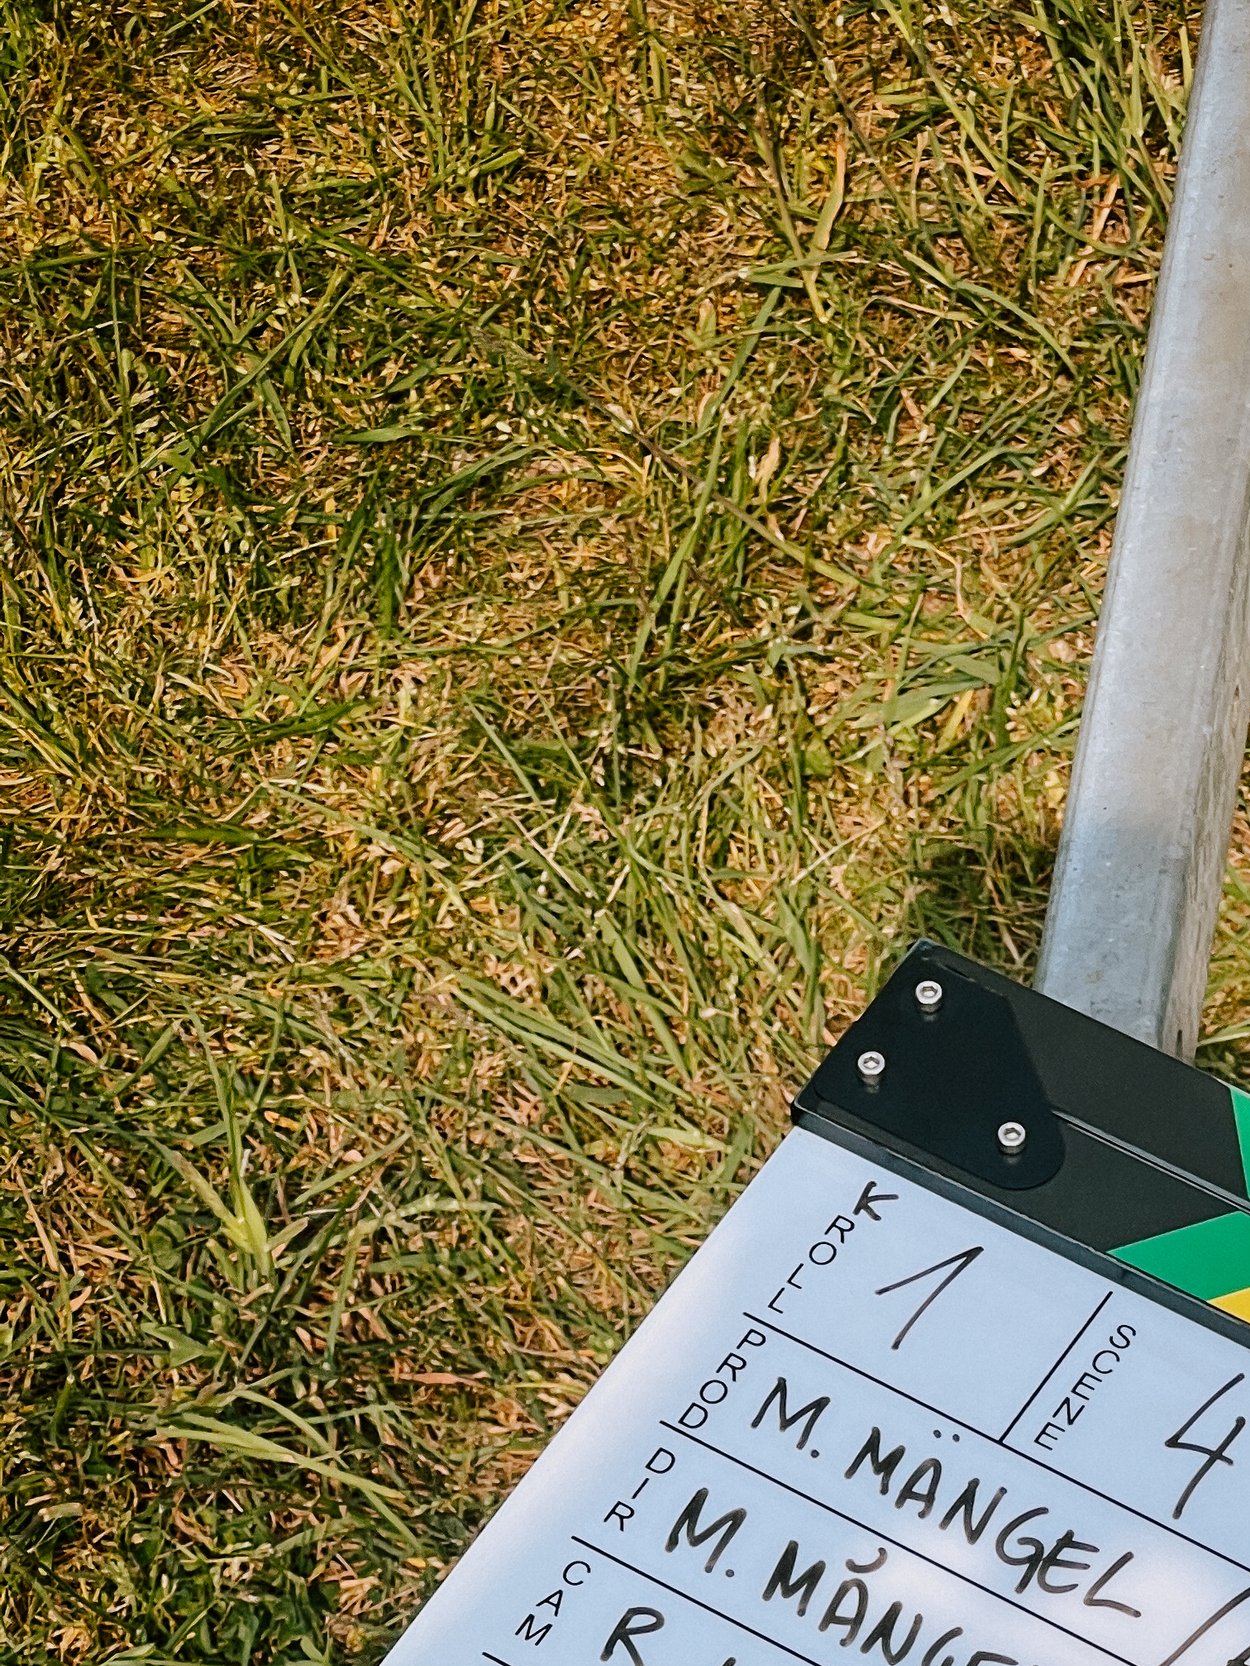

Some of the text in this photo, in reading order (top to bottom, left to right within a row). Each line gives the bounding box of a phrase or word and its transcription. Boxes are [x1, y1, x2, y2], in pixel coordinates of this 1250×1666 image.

[768, 1215, 855, 1313] ROLL
[876, 1247, 984, 1349] 1
[677, 1329, 767, 1429] PROD
[1033, 1324, 1137, 1451] SCENE
[603, 1448, 675, 1531] DIR
[1165, 1373, 1245, 1519] 4
[665, 1488, 747, 1578] M.
[752, 1377, 831, 1459] M.
[845, 1427, 1141, 1617] MÄNGEL
[515, 1560, 591, 1647] CAM
